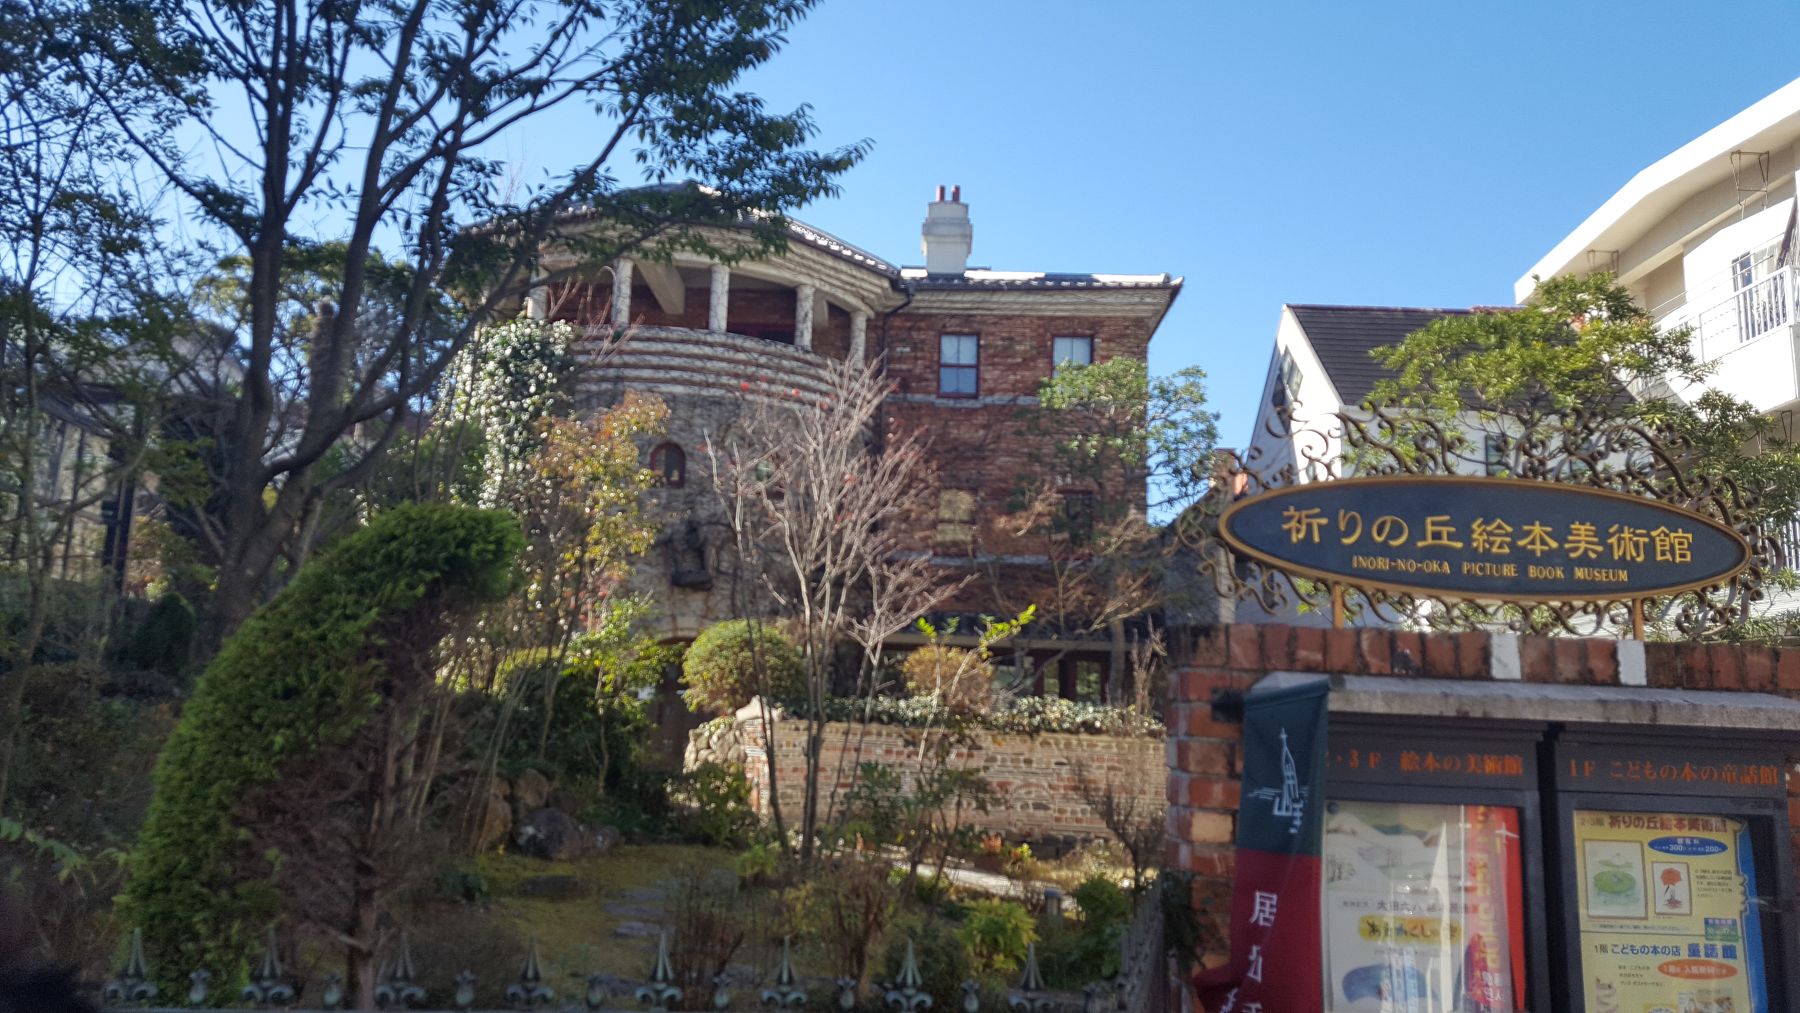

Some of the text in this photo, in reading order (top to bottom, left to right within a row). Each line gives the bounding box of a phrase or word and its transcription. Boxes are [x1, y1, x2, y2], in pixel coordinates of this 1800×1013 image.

[1281, 505, 1693, 564] 祈りの丘絵本美術館
[1352, 555, 1629, 582] INORI-NO-OKA PICTURE BOOK MUSEUM
[1611, 944, 1681, 957] こどもの本の店
